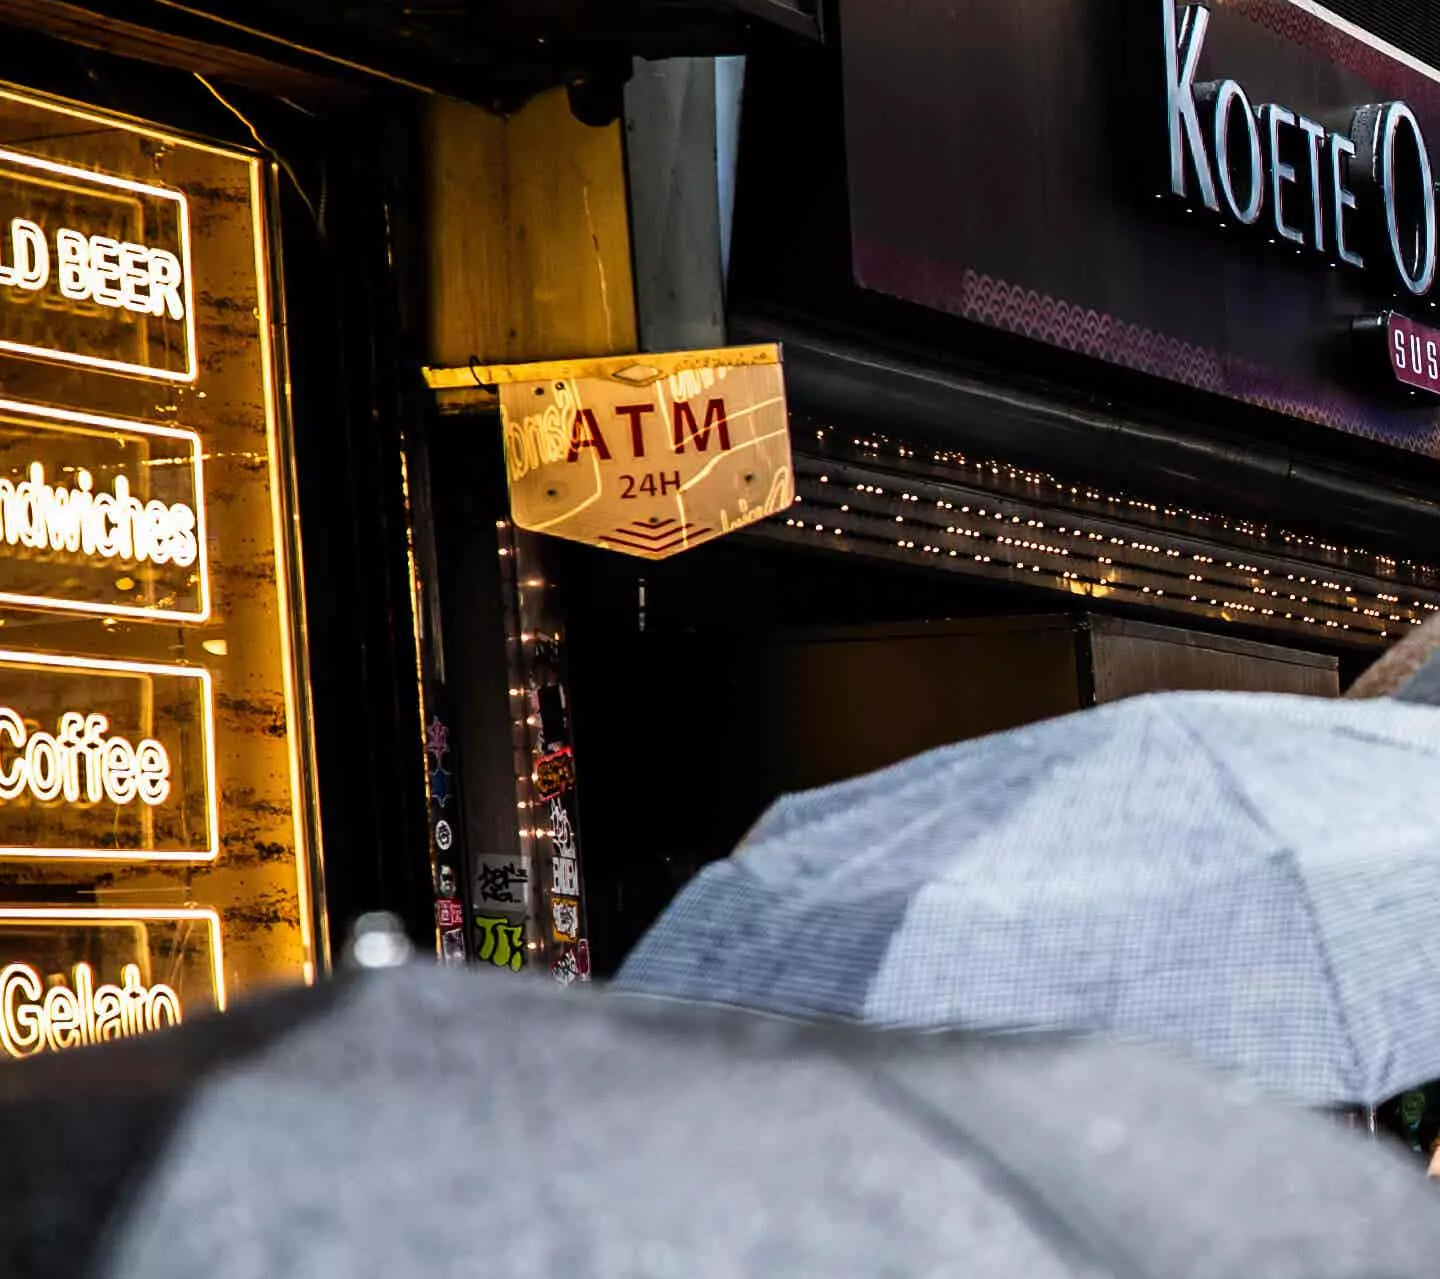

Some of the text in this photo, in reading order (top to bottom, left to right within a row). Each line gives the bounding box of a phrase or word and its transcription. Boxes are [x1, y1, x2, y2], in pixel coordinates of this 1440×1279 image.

[57, 227, 184, 320] BEER
[567, 398, 731, 463] ATM
[619, 471, 680, 499] 24H
[0, 707, 171, 806] Coffee
[0, 962, 182, 1059] Gelato
